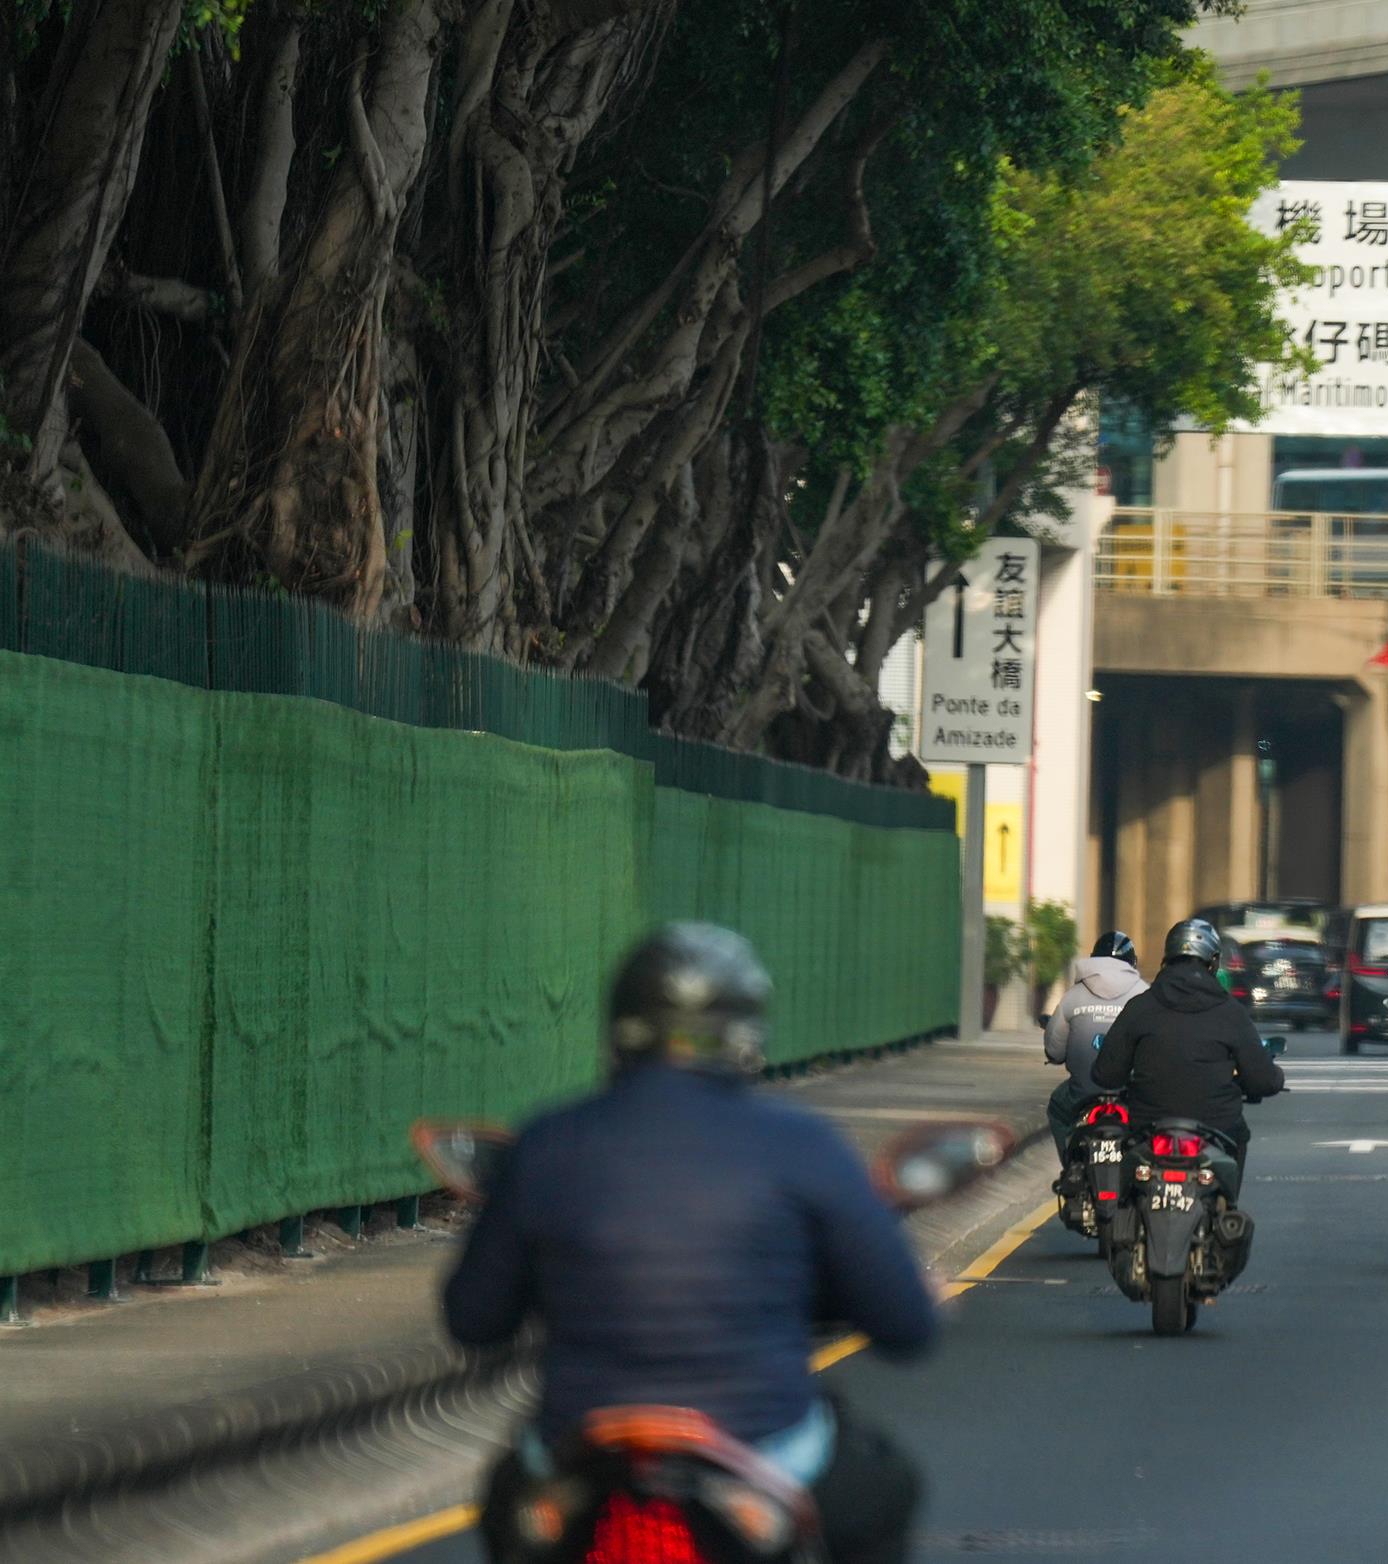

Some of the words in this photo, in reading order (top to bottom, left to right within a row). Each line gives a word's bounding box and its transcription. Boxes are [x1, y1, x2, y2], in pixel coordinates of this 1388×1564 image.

[991, 551, 1028, 690] 友誼大橋
[931, 692, 990, 714] Ponte
[996, 696, 1021, 717] da
[933, 726, 1018, 748] Amizade
[1100, 1140, 1117, 1152] MX
[1164, 1183, 1184, 1197] MR
[1151, 1195, 1195, 1213] 21-47
